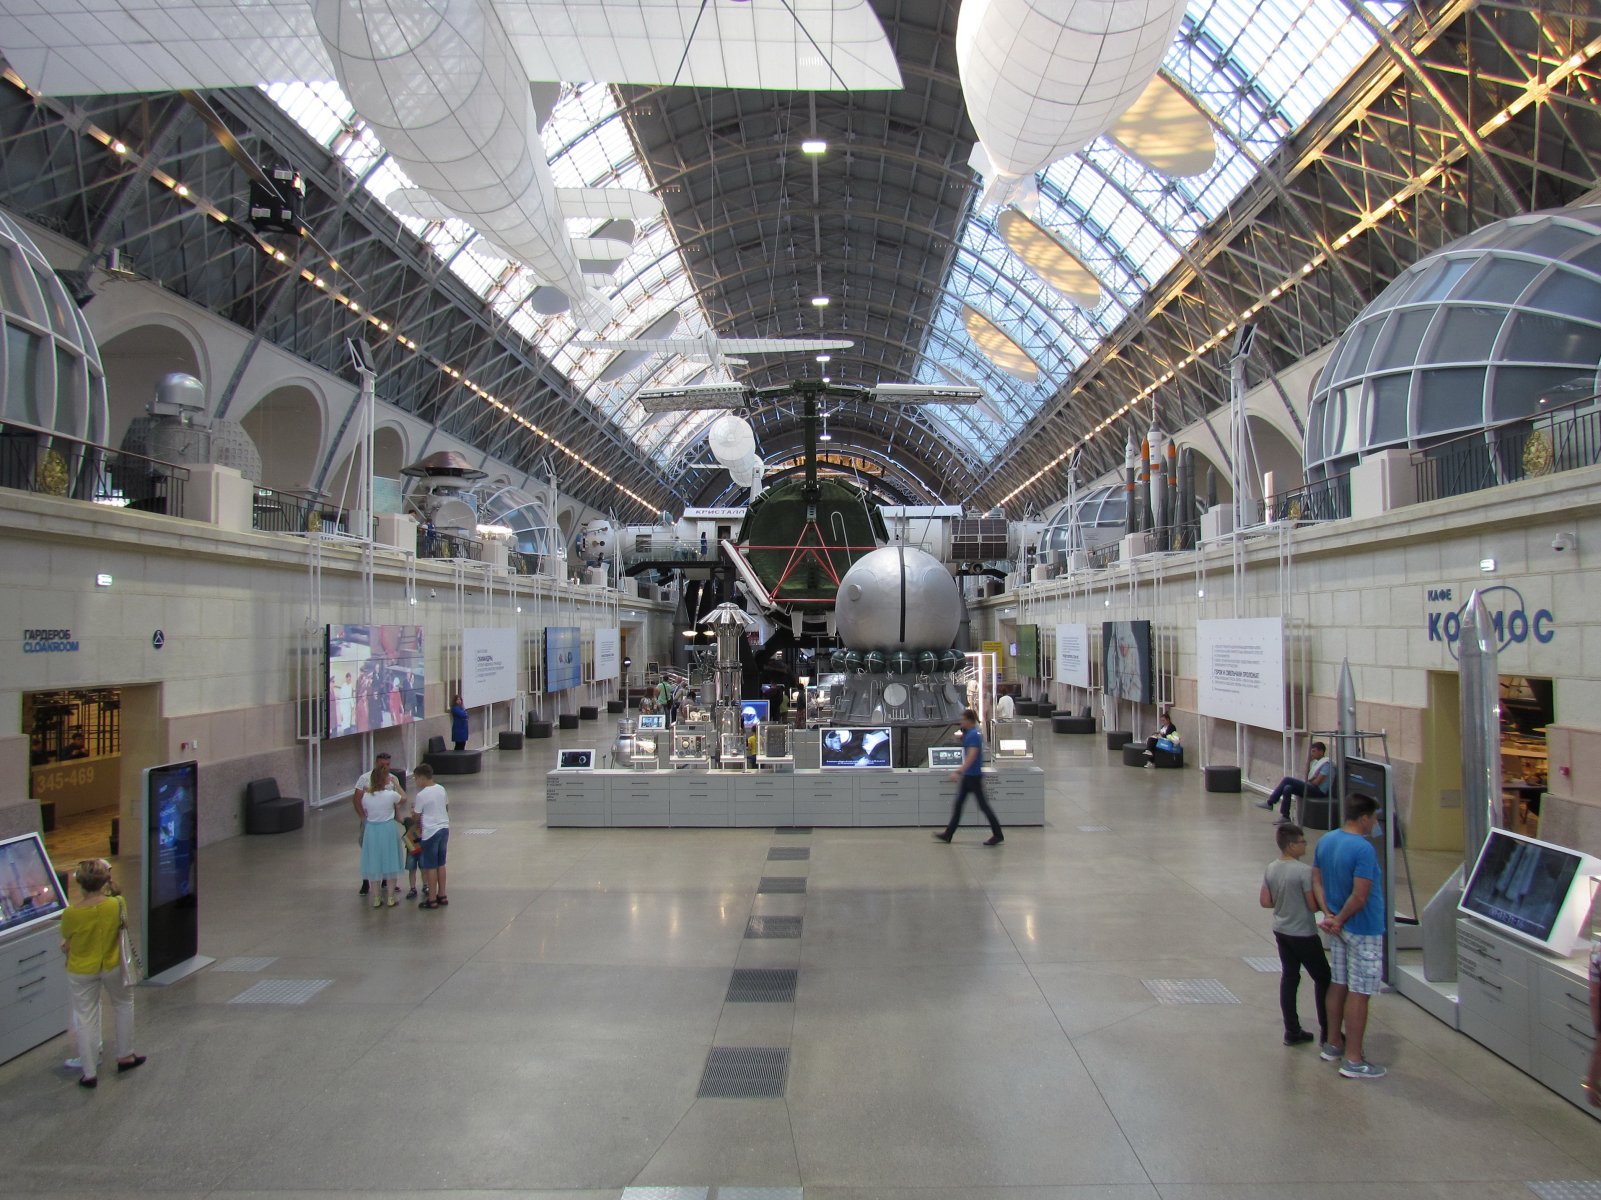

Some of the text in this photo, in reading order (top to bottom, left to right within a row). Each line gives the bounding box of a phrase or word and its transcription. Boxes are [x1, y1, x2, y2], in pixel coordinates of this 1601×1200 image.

[1427, 588, 1452, 602] КАФЕ
[1428, 608, 1555, 644] КОМОС
[23, 629, 71, 641] ГАРДЕРОБ
[23, 641, 79, 653] CLOAKROOM
[36, 766, 95, 793] 345-469
